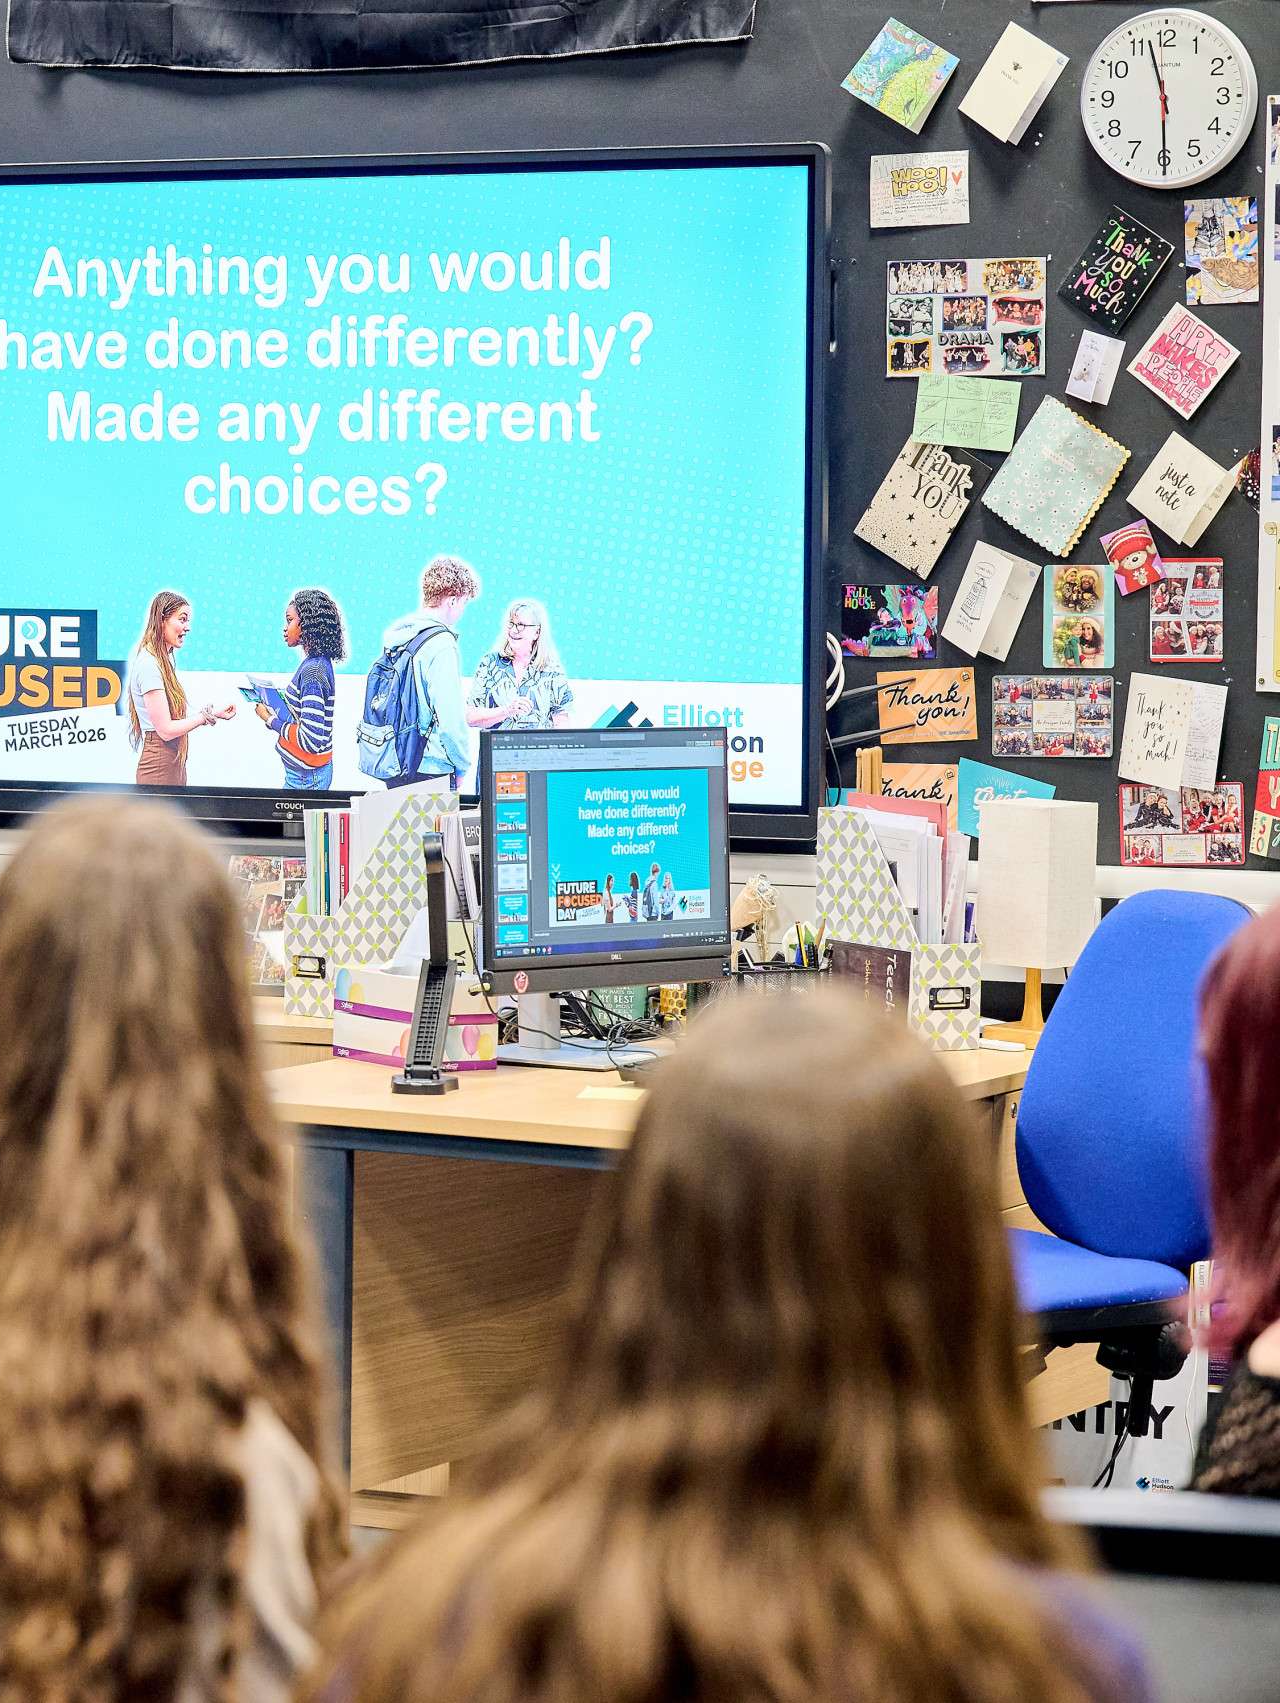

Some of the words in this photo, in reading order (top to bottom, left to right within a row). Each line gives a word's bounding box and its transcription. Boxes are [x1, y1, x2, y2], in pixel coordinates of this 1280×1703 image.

[1130, 38, 1144, 56] 11
[1156, 29, 1177, 48] 12
[1192, 37, 1198, 54] 1
[1107, 61, 1129, 79] 10
[1210, 57, 1224, 76] 2
[1101, 90, 1115, 108] 9
[1216, 87, 1230, 105] 3
[1107, 119, 1121, 137] 8
[1207, 116, 1221, 135] 4
[1128, 140, 1142, 159] 7
[1157, 149, 1171, 167] 6
[1187, 139, 1201, 158] 5
[33, 243, 288, 310] Anything
[304, 252, 411, 308] you
[428, 236, 611, 294] would
[145, 316, 289, 370] done
[306, 311, 654, 380] differently?
[937, 332, 994, 346] DRAMA
[1169, 314, 1230, 366] ART
[1145, 353, 1205, 400] PEOPLE
[46, 389, 201, 443] Made
[218, 401, 322, 456] any
[337, 388, 601, 443] different
[184, 462, 448, 516] choices?
[911, 475, 961, 520] YOU
[1155, 483, 1182, 511] note
[845, 585, 872, 599] FULL
[844, 597, 877, 610] HOUSE
[884, 681, 962, 708] Thank
[1136, 692, 1167, 720] Thank
[663, 704, 744, 729] Elliott
[7, 716, 80, 737] TUESDAY
[1144, 720, 1165, 739] you
[5, 732, 63, 752] MARCH
[67, 728, 107, 746] 2026
[1152, 733, 1164, 749] so
[1145, 739, 1178, 762] much!
[584, 787, 629, 804] Anything
[630, 789, 648, 803] you
[650, 785, 680, 800] would
[881, 778, 945, 800] hank
[275, 802, 305, 810] CTOUCH
[578, 807, 602, 820] have
[604, 805, 629, 819] done
[631, 803, 686, 820] differently?
[587, 824, 615, 838] Made
[616, 826, 635, 840] any
[637, 822, 679, 836] different
[611, 840, 655, 855] choices?
[557, 882, 597, 895] FUTURE
[557, 894, 603, 908] FOCUSED
[557, 908, 577, 921] DAY
[611, 952, 624, 961] DELL
[613, 995, 634, 1004] BEST
